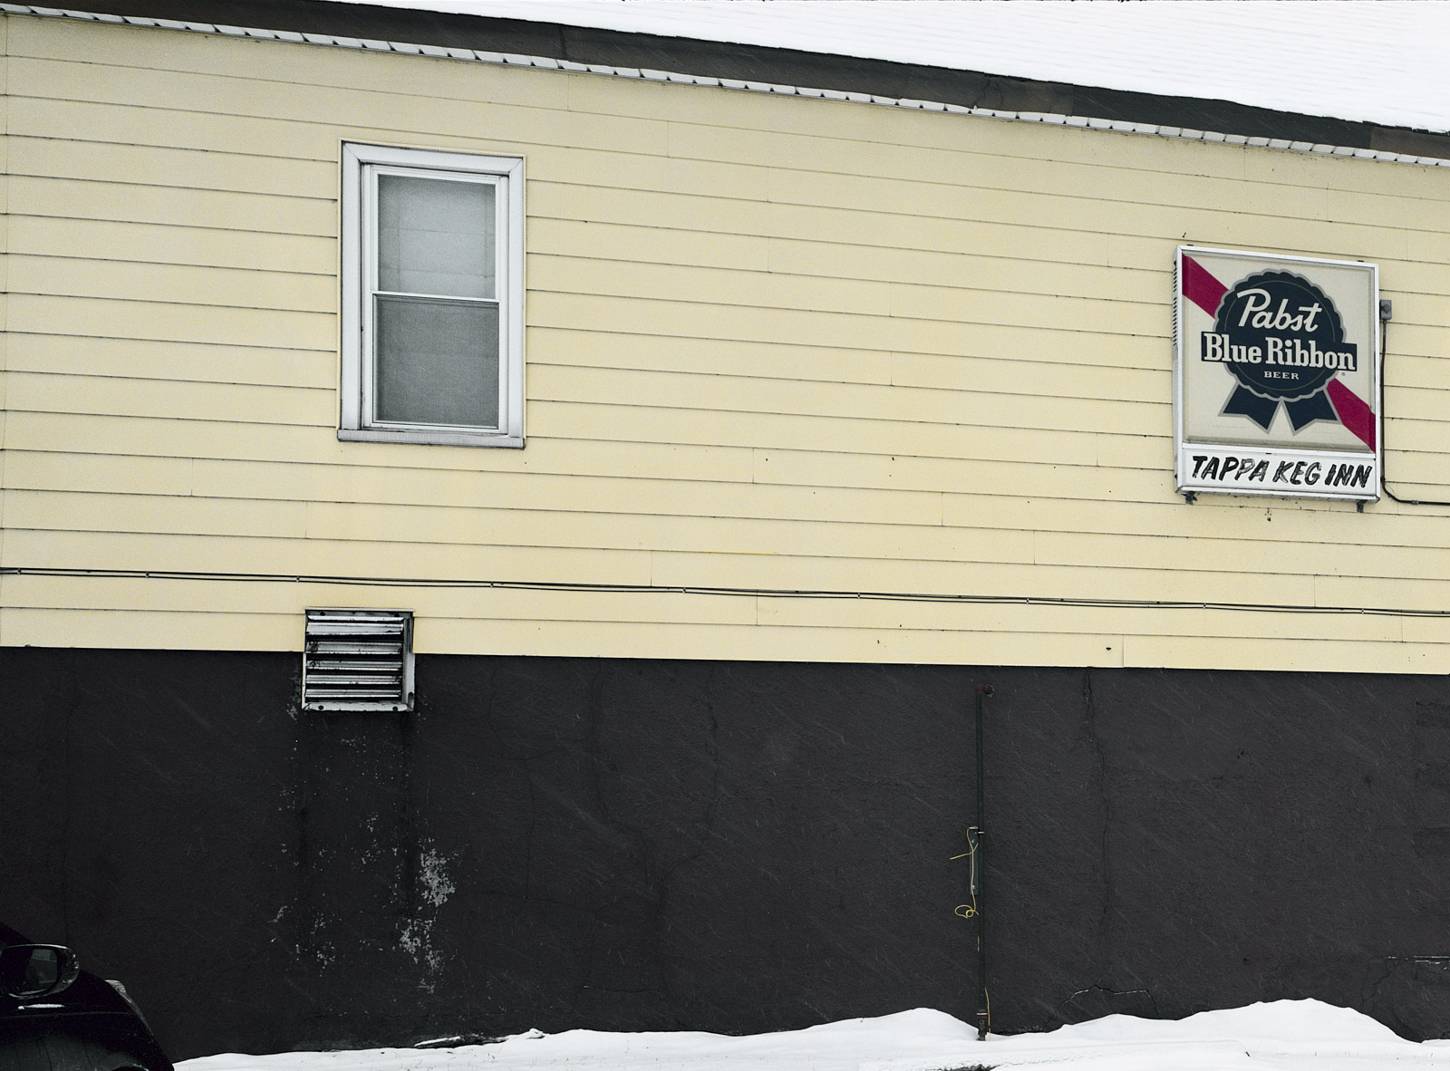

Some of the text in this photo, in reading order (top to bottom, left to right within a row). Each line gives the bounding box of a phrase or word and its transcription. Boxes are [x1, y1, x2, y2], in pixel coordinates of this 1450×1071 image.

[1237, 288, 1322, 333] Pabst
[1204, 333, 1356, 371] Blue Ribbon
[1264, 370, 1300, 380] BEER
[1192, 455, 1372, 488] TAPPA KEG INN
